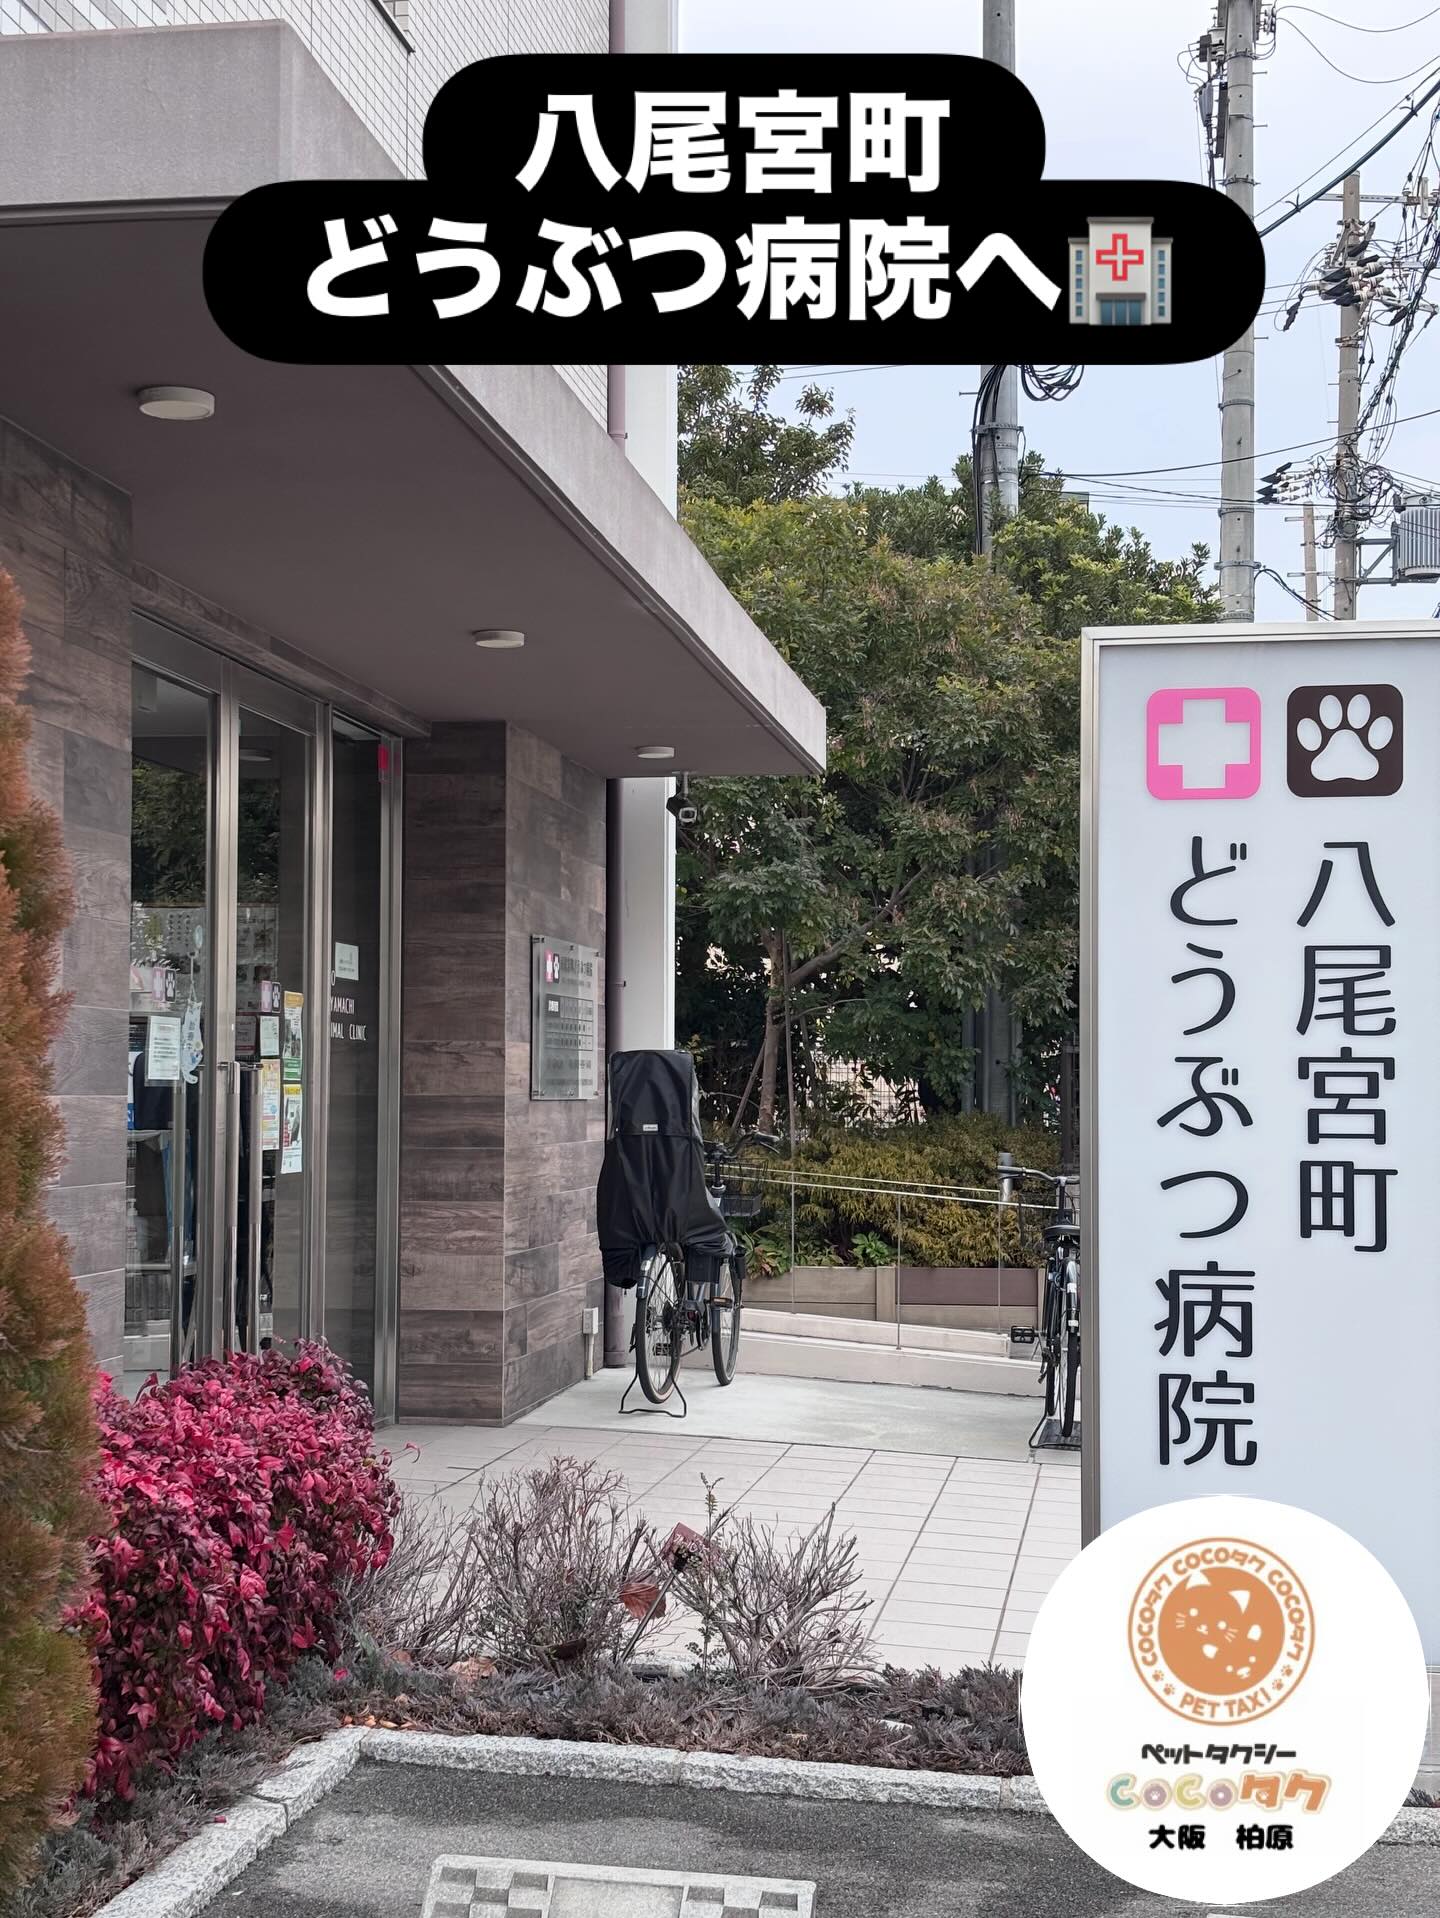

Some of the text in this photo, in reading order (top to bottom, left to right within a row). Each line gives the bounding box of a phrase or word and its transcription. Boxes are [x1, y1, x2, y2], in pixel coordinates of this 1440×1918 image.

[349, 1024, 366, 1040] CLINIC
[1155, 836, 1257, 1466] どうぶつ病院
[1297, 842, 1398, 1252] 八尾宮町
